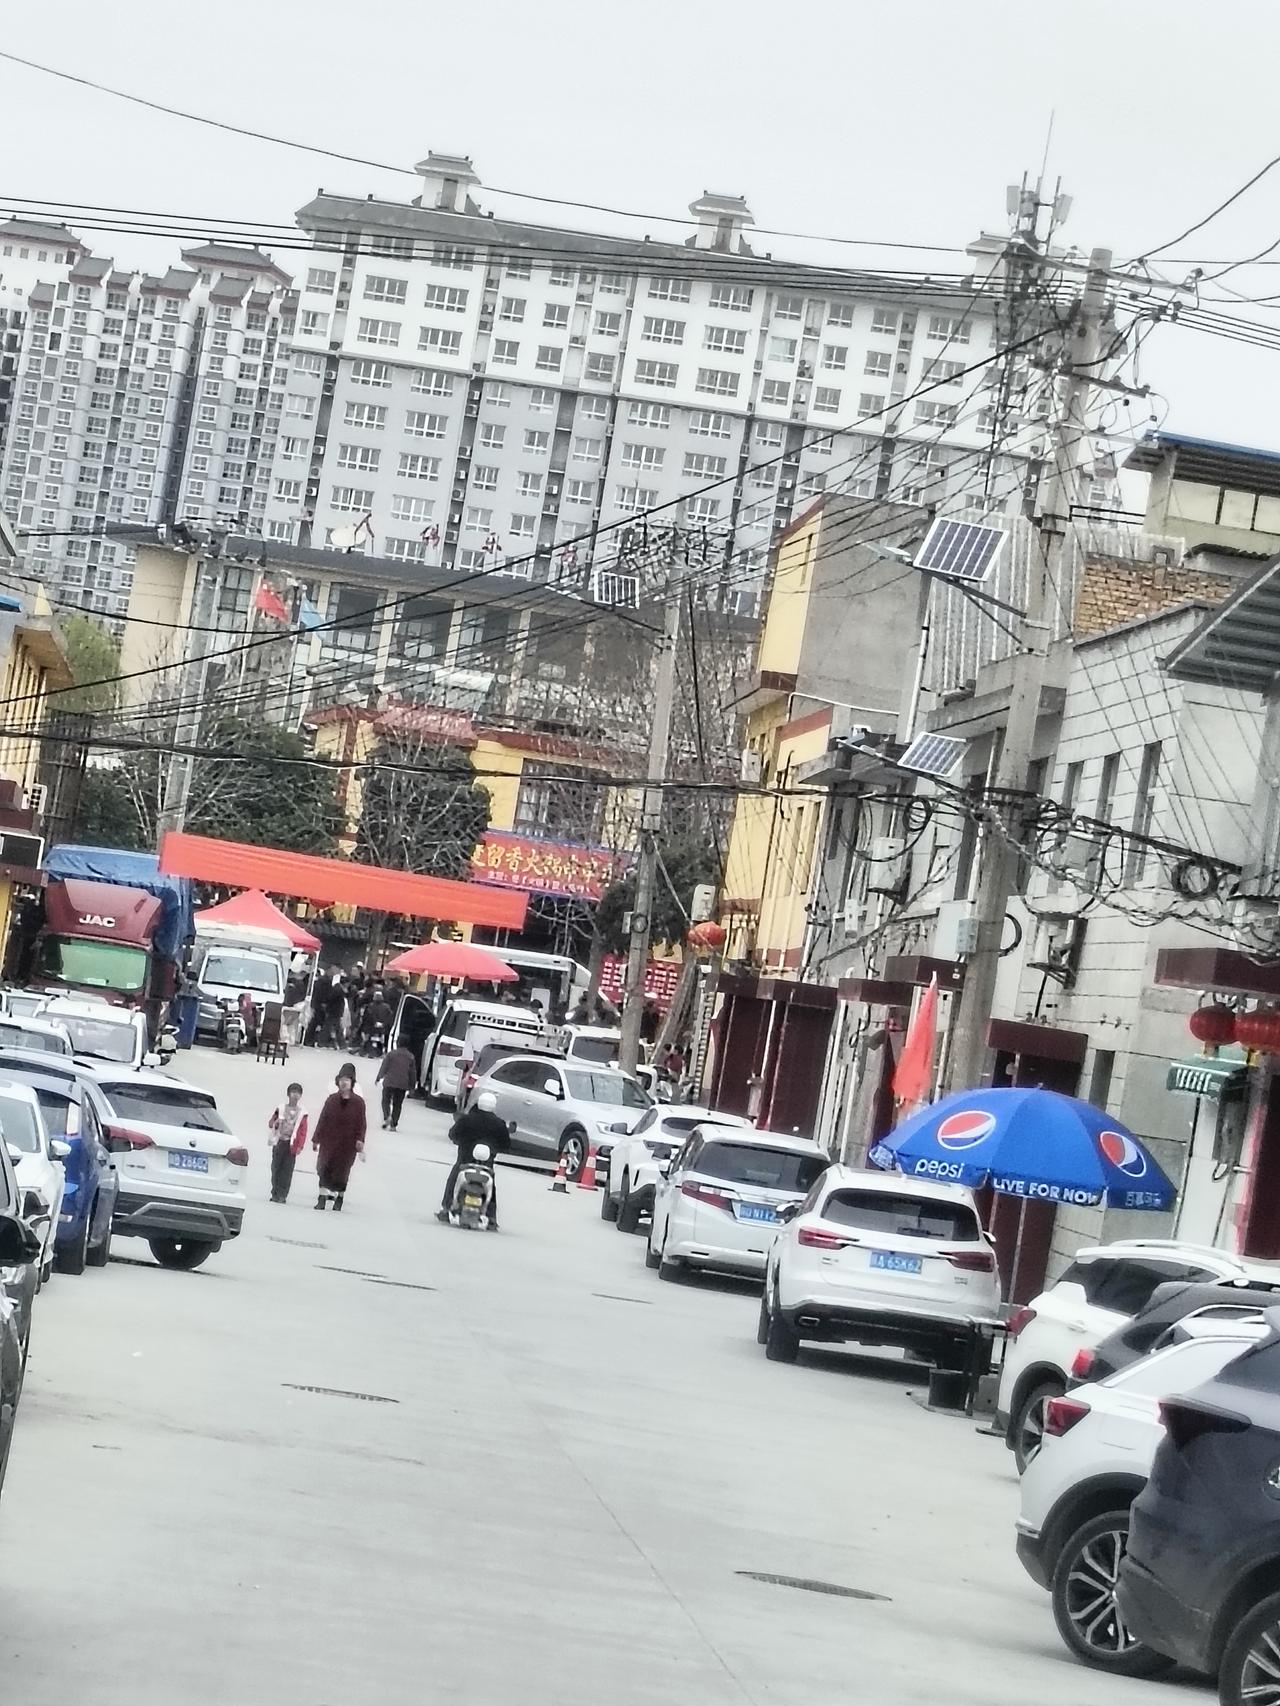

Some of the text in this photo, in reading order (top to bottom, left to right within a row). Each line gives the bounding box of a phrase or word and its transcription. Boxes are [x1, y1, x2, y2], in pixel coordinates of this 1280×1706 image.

[78, 914, 116, 928] JAC
[914, 1158, 966, 1180] pepsi
[993, 1177, 1025, 1194] LIVE
[1028, 1182, 1060, 1199] FOR
